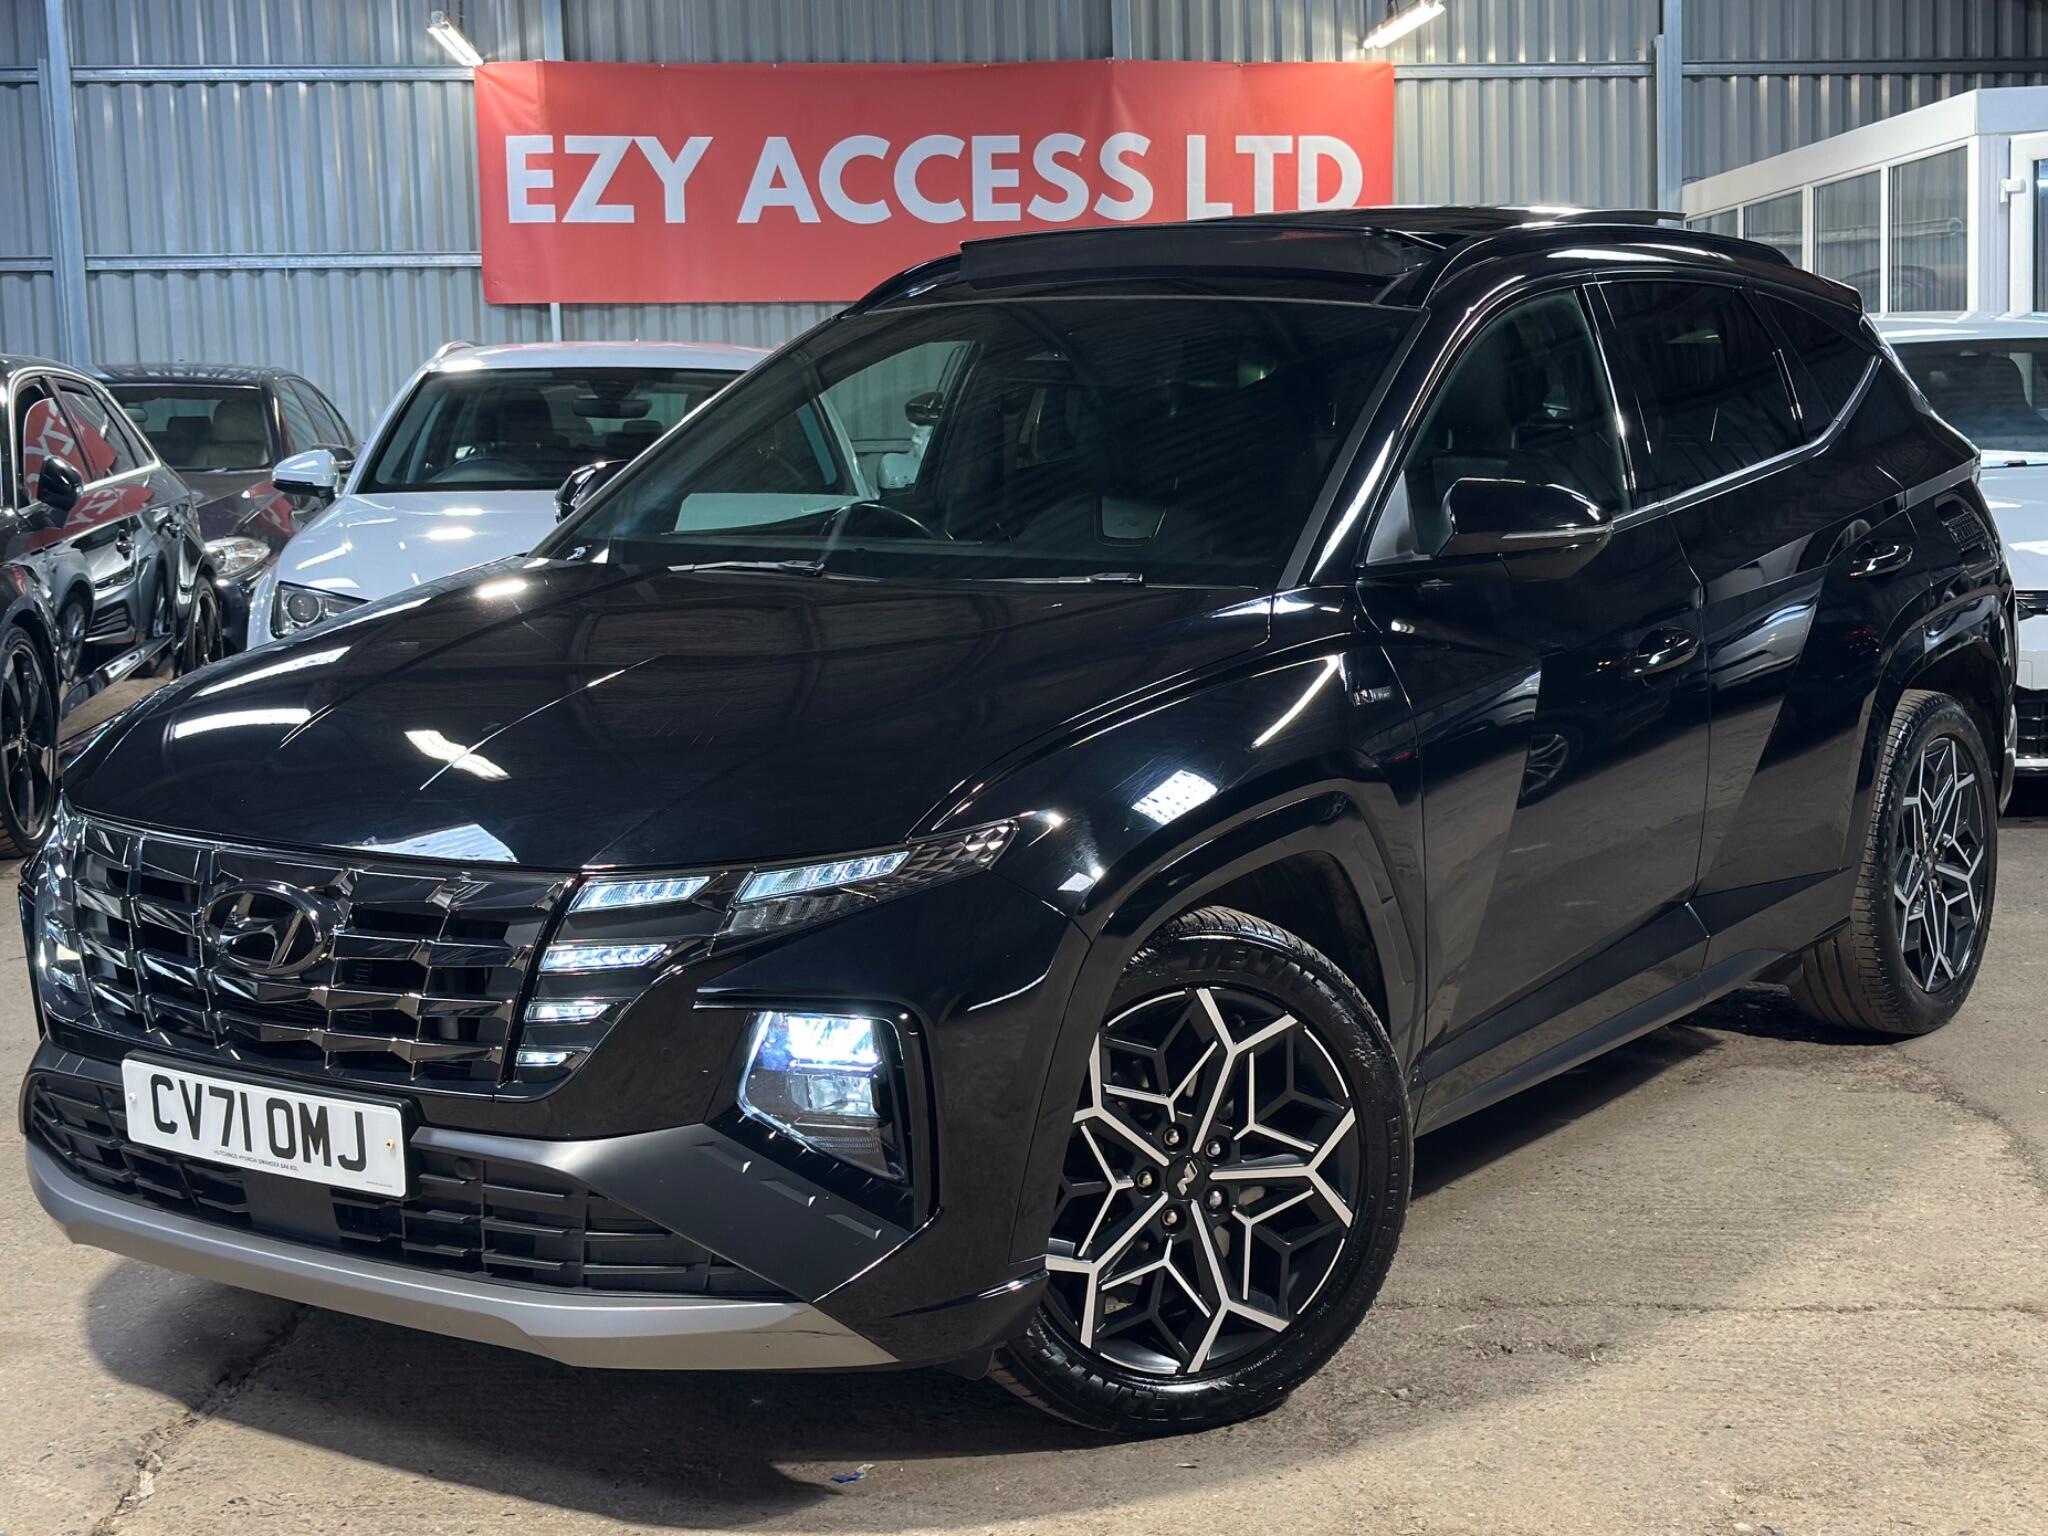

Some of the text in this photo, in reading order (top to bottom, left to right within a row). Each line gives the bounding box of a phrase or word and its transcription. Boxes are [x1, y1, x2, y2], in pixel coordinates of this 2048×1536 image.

[506, 132, 1363, 223] EZY ACCESS LTD
[150, 1073, 367, 1173] CV71 OMJ
